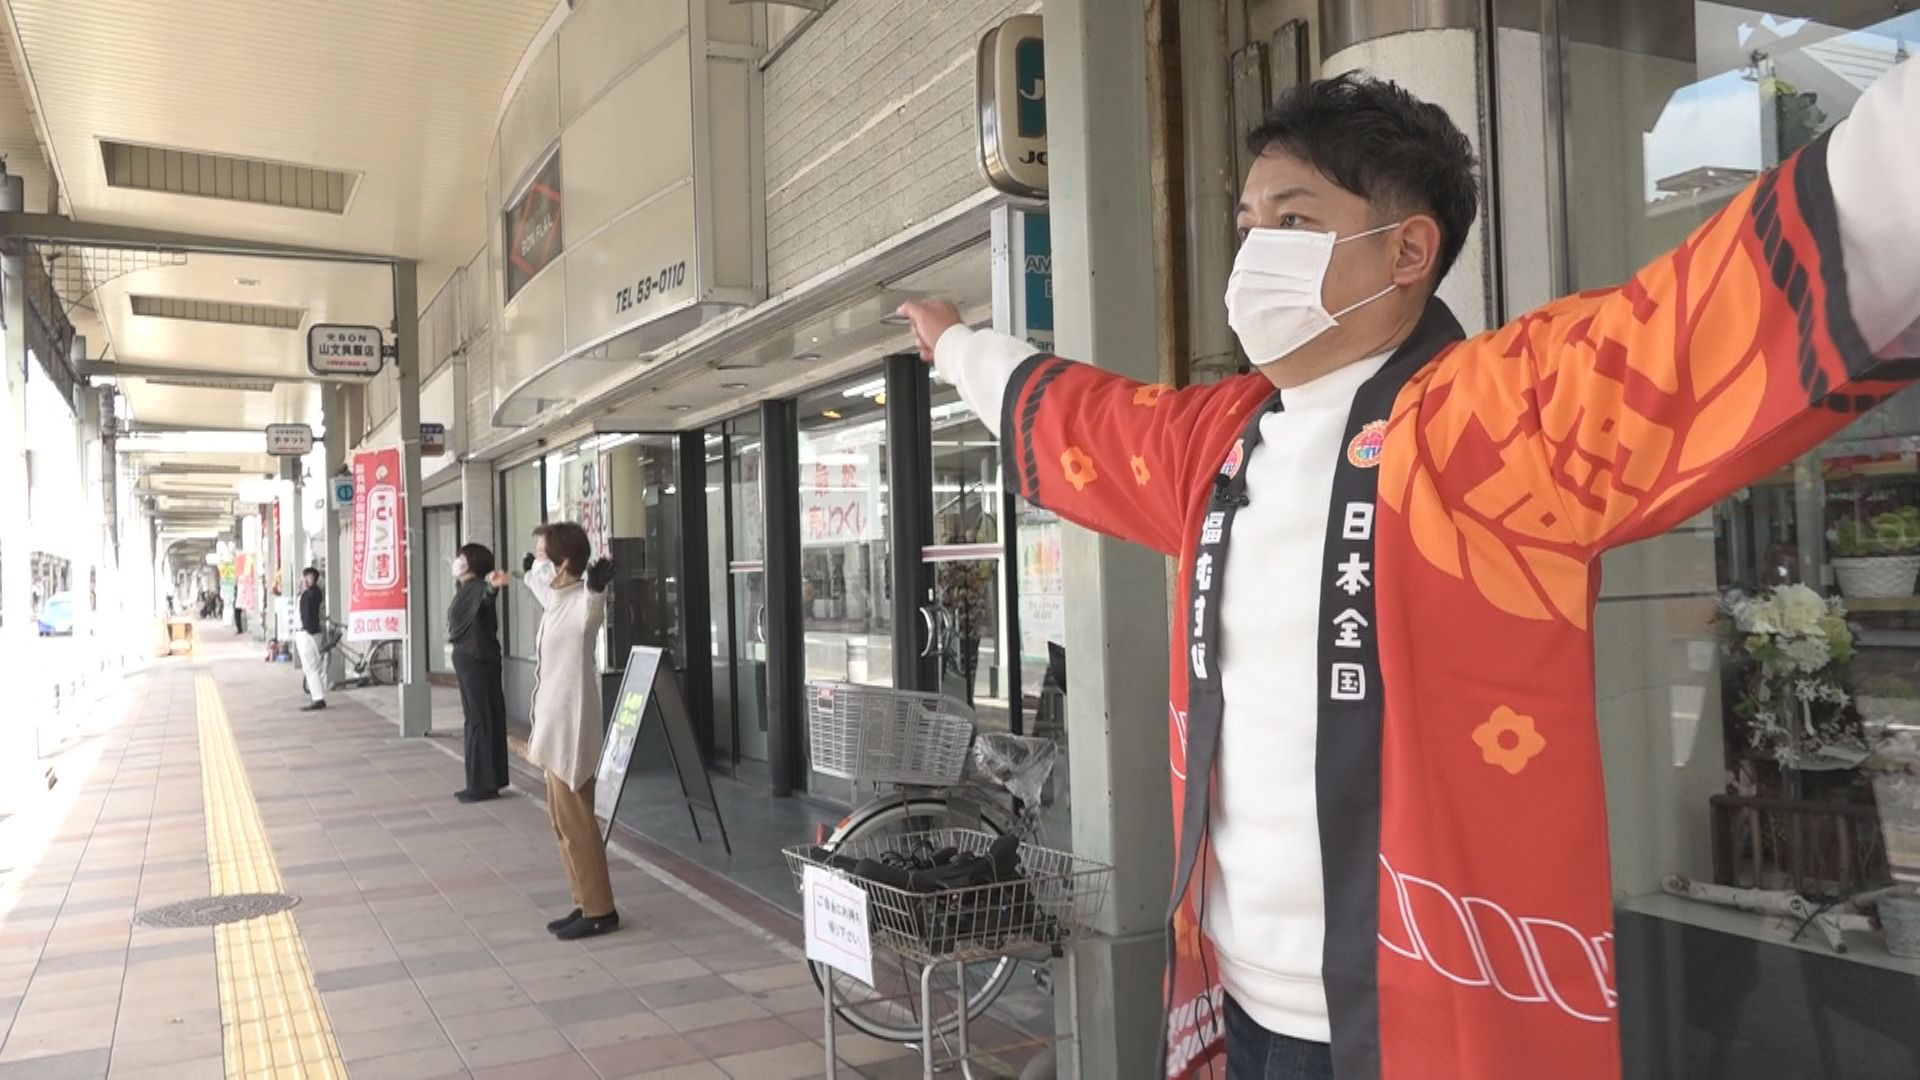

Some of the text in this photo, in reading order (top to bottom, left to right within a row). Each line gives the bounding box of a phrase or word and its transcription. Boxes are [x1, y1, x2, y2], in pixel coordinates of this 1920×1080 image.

[616, 285, 633, 314] TEL
[1330, 500, 1375, 701] 日本全国
